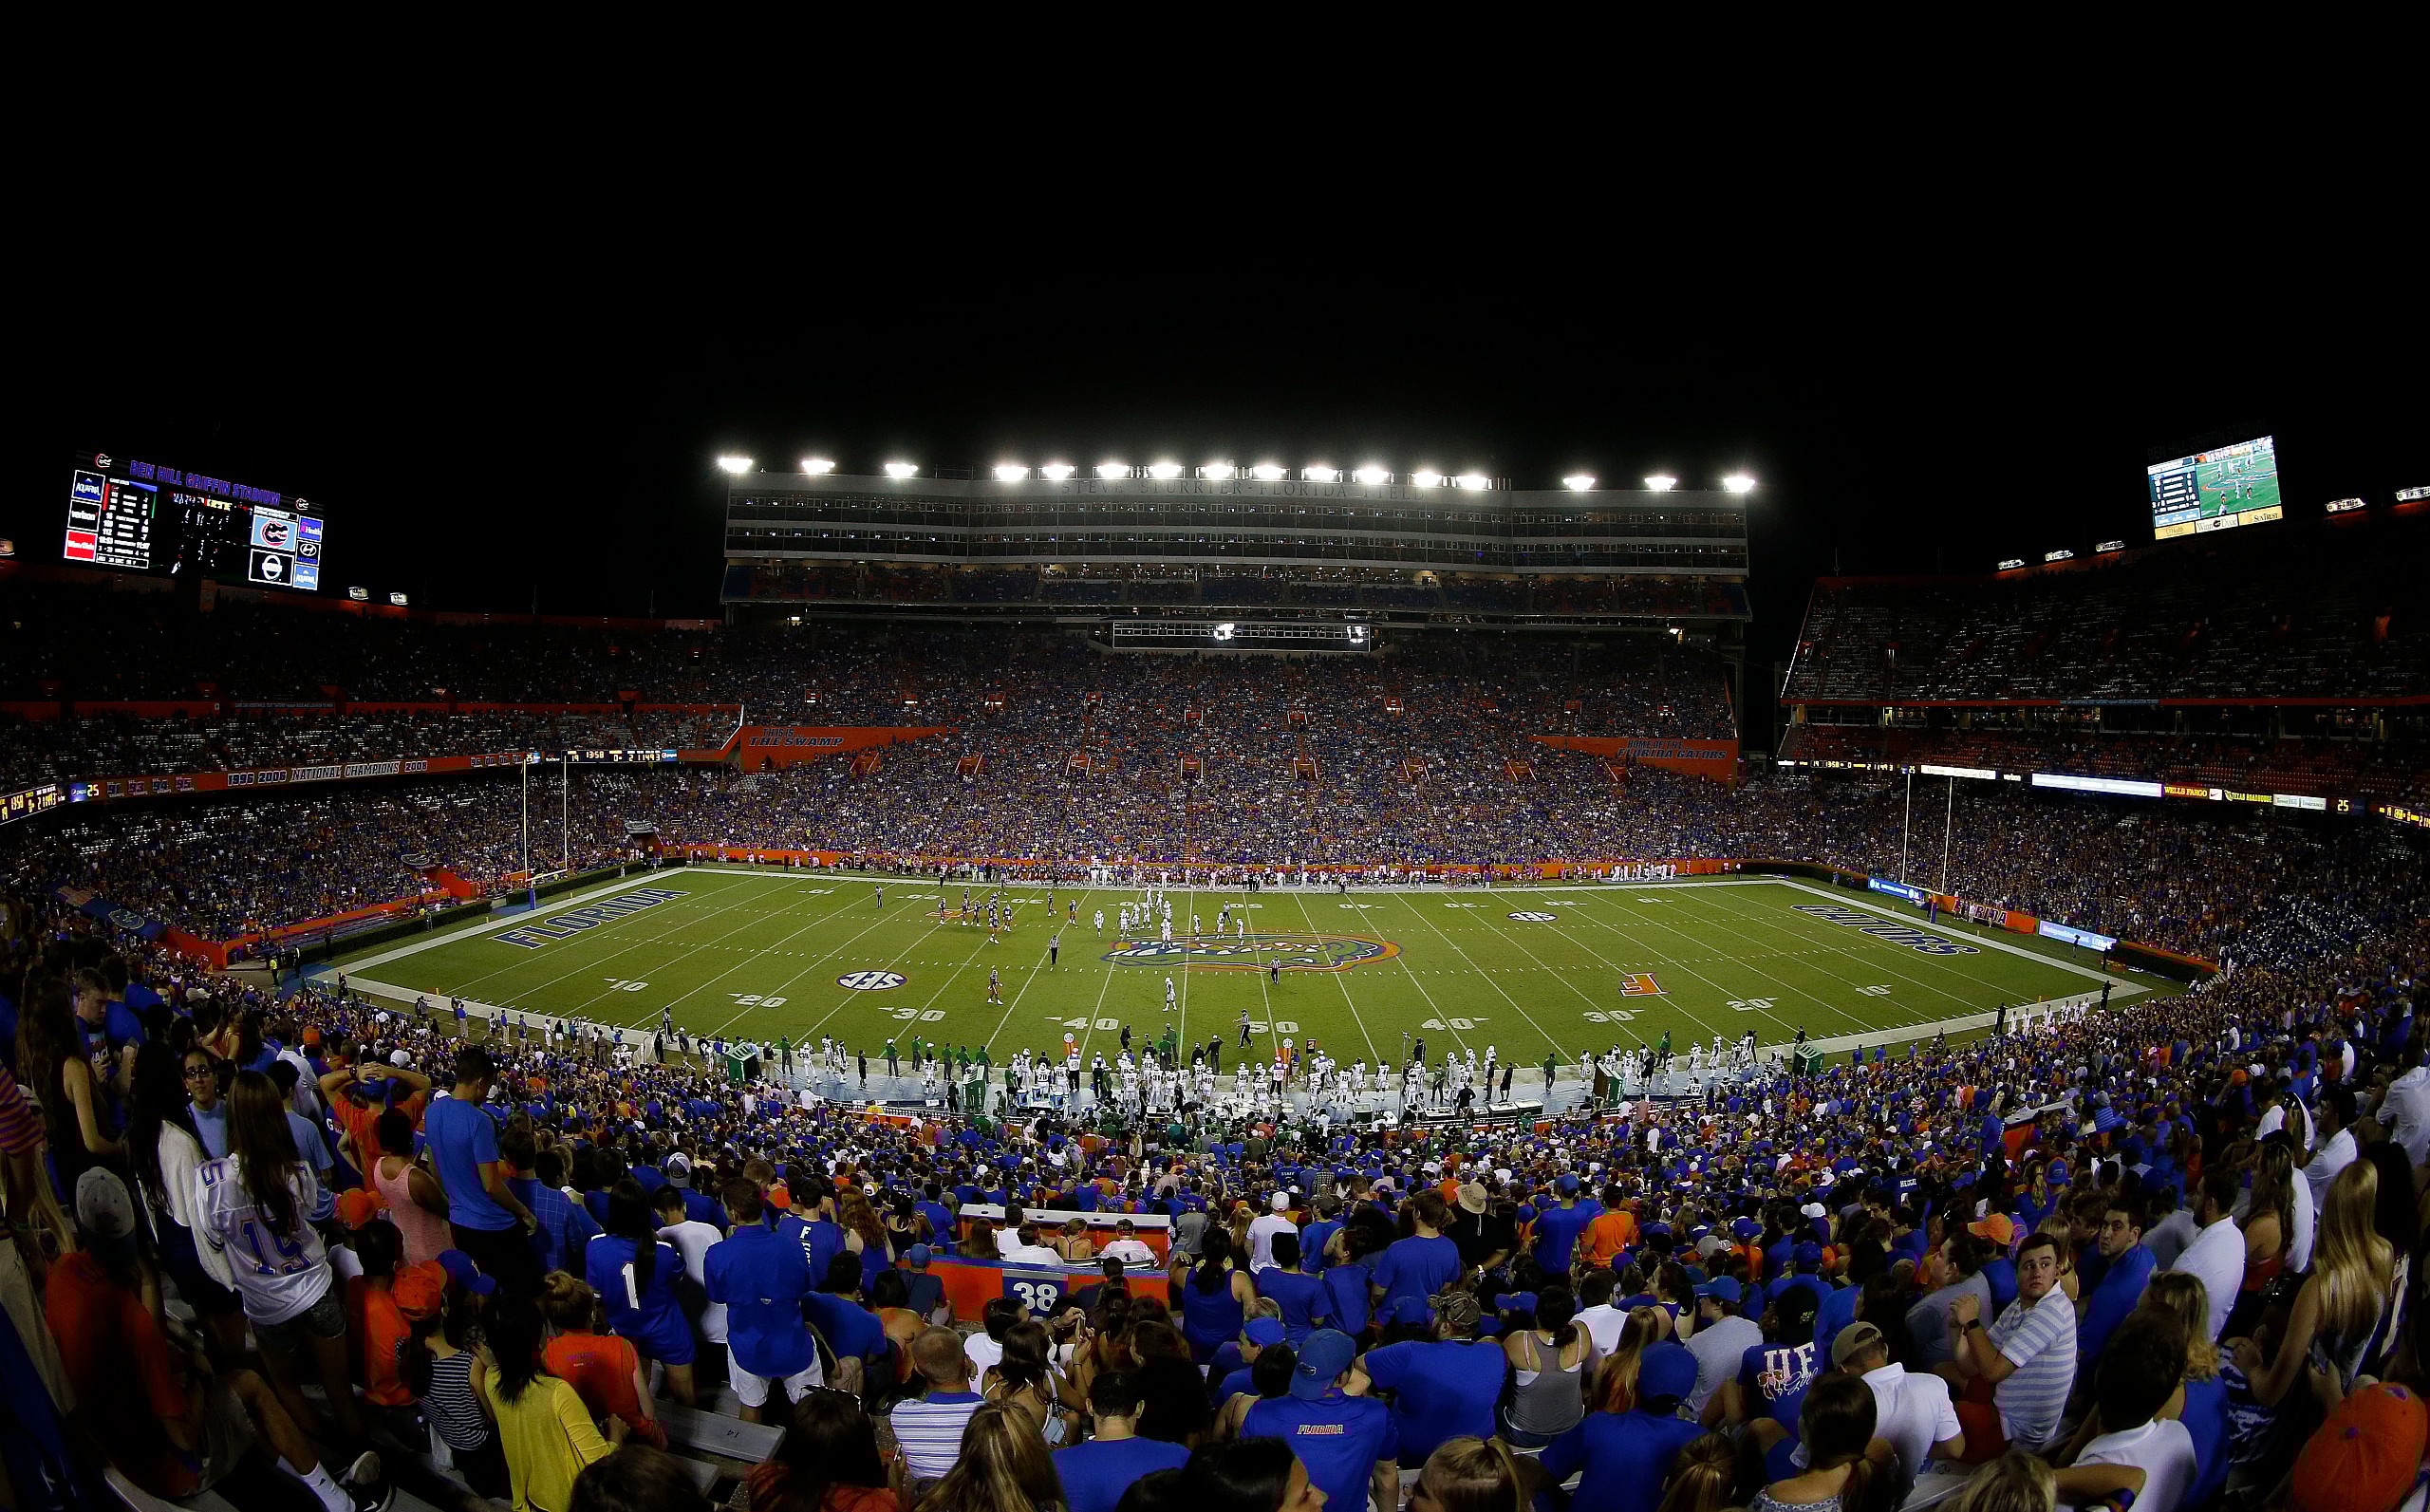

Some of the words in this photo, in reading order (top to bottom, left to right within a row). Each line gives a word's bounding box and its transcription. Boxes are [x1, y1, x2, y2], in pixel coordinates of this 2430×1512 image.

[129, 460, 155, 479] BEN
[157, 465, 182, 485] HILL
[186, 473, 231, 495] GRIFFIN
[233, 483, 280, 506] STADIUM
[1260, 482, 1347, 497] FLORIDA
[2196, 520, 2214, 532] Winn
[762, 728, 783, 737] THIS
[749, 737, 783, 747] THE
[783, 737, 844, 747] SWAMP
[1628, 739, 1651, 748] HOME
[1653, 740, 1664, 749] OF
[1617, 747, 1673, 758] FLORIDA
[1676, 749, 1728, 759] GATORS
[227, 773, 254, 786] 1996
[258, 771, 287, 784] 2006
[290, 765, 343, 782] NATIONAL
[345, 760, 401, 777] CHAMPIONS
[404, 760, 427, 772] 2008
[86, 784, 100, 796] 25
[128, 781, 144, 793] 93
[152, 779, 168, 792] 94
[176, 777, 192, 790] 95
[2164, 786, 2185, 795] WELLS
[2186, 788, 2208, 797] FARGO
[2337, 799, 2349, 812] 25
[487, 887, 691, 950] FLORIDA
[1790, 905, 1980, 955] GATORS
[619, 979, 649, 992] 10
[1855, 984, 1892, 997] 10
[733, 994, 788, 1008] 20
[1726, 999, 1775, 1012] 20
[891, 1008, 947, 1022] 30
[1582, 1009, 1636, 1023] 30
[1062, 1017, 1120, 1031] 40
[1248, 1021, 1299, 1034] 50
[1421, 1017, 1476, 1031] 40
[1307, 1040, 1316, 1050] 2
[240, 1219, 313, 1275] 15
[620, 1261, 641, 1311] 1
[1013, 1282, 1058, 1311] 38
[1297, 1424, 1344, 1435] FLORIDA
